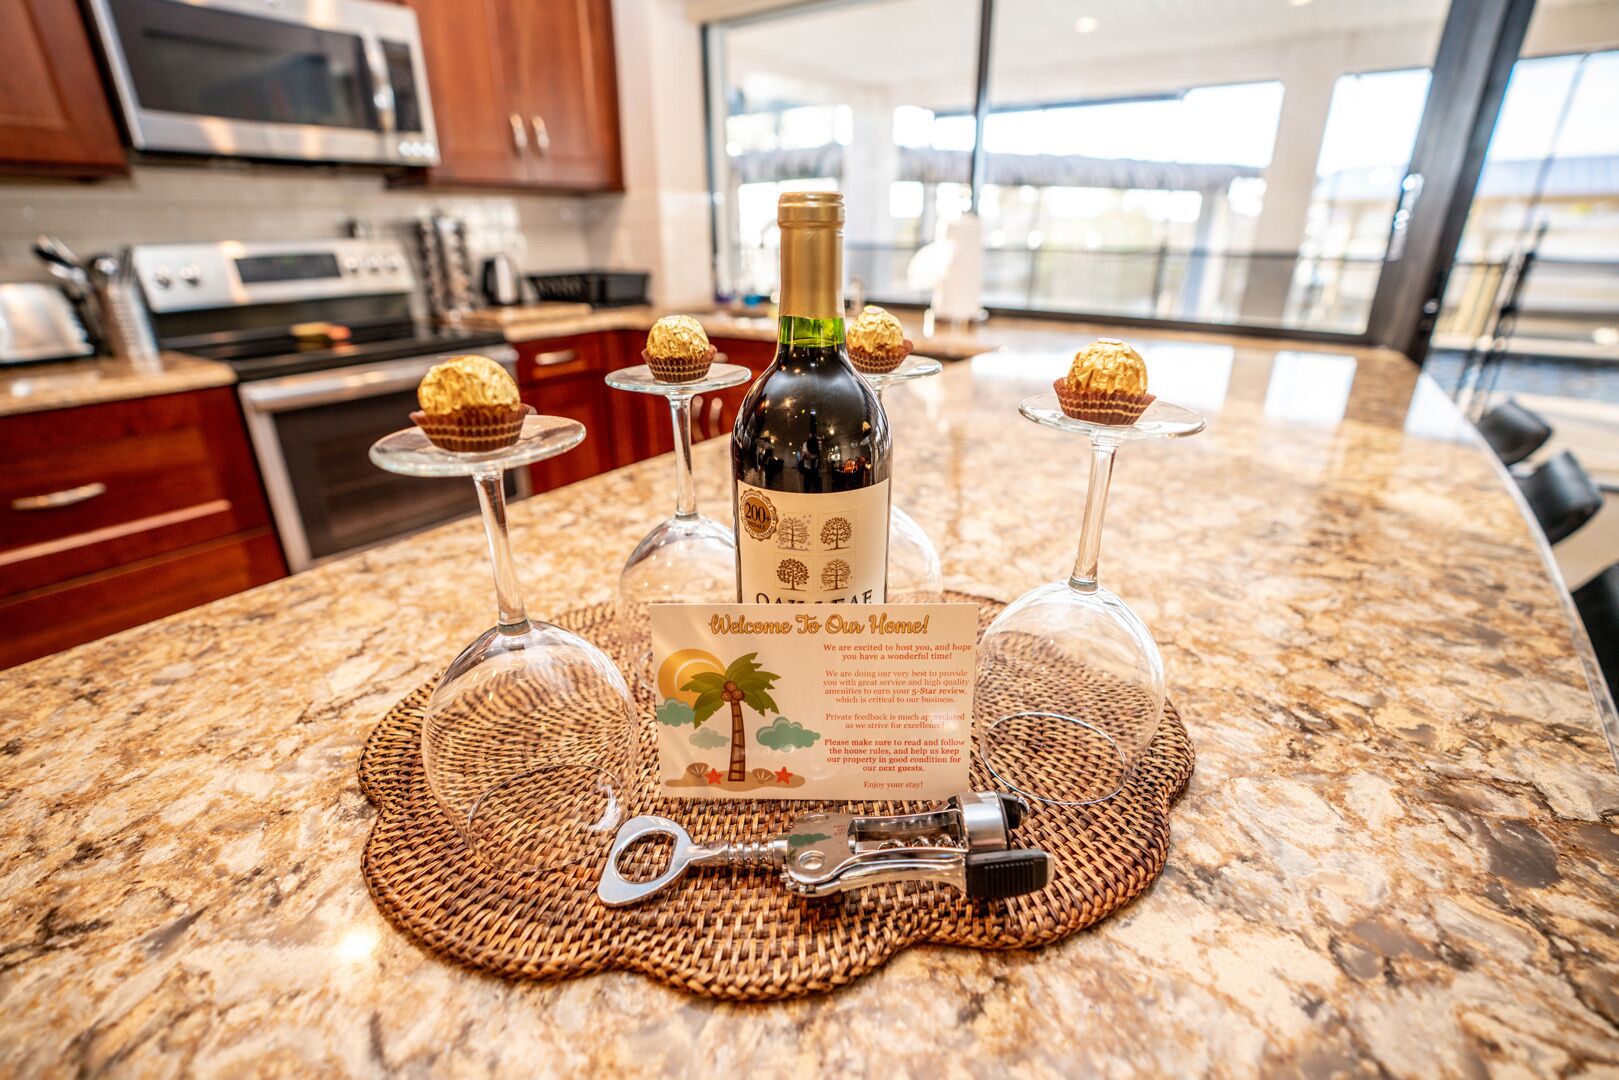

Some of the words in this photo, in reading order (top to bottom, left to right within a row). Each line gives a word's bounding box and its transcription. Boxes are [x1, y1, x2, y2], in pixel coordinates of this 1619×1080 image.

[744, 501, 771, 523] 200+
[709, 613, 793, 634] Welcome
[795, 613, 822, 634] To
[825, 614, 865, 634] Our
[868, 613, 929, 634] Home!
[824, 643, 837, 651] We
[854, 643, 884, 651] excited
[896, 643, 913, 651] host
[915, 645, 933, 653] you,
[935, 643, 950, 651] and
[953, 643, 972, 653] hope
[842, 654, 857, 662] you
[860, 652, 878, 660] have
[888, 652, 929, 660] wonderful
[931, 652, 952, 660] time!
[854, 670, 876, 679] doing
[893, 671, 909, 679] very
[939, 670, 968, 679] provide
[824, 680, 837, 688] you
[858, 679, 877, 688] great
[924, 679, 941, 688] high
[943, 679, 970, 688] quality
[825, 687, 862, 695] amenities
[912, 687, 936, 695] 5-Star
[826, 713, 853, 721] Private
[854, 713, 888, 721] feedback
[890, 713, 896, 721] is
[898, 713, 918, 721] much
[920, 713, 965, 723] apreciated
[870, 747, 891, 755] rules,
[911, 747, 928, 756] help
[941, 747, 960, 756] keep
[843, 757, 877, 765] property
[889, 756, 908, 765] good
[898, 765, 925, 774] guests.
[864, 781, 885, 790] Enjoy
[887, 782, 903, 790] your
[906, 781, 923, 790] stay!
